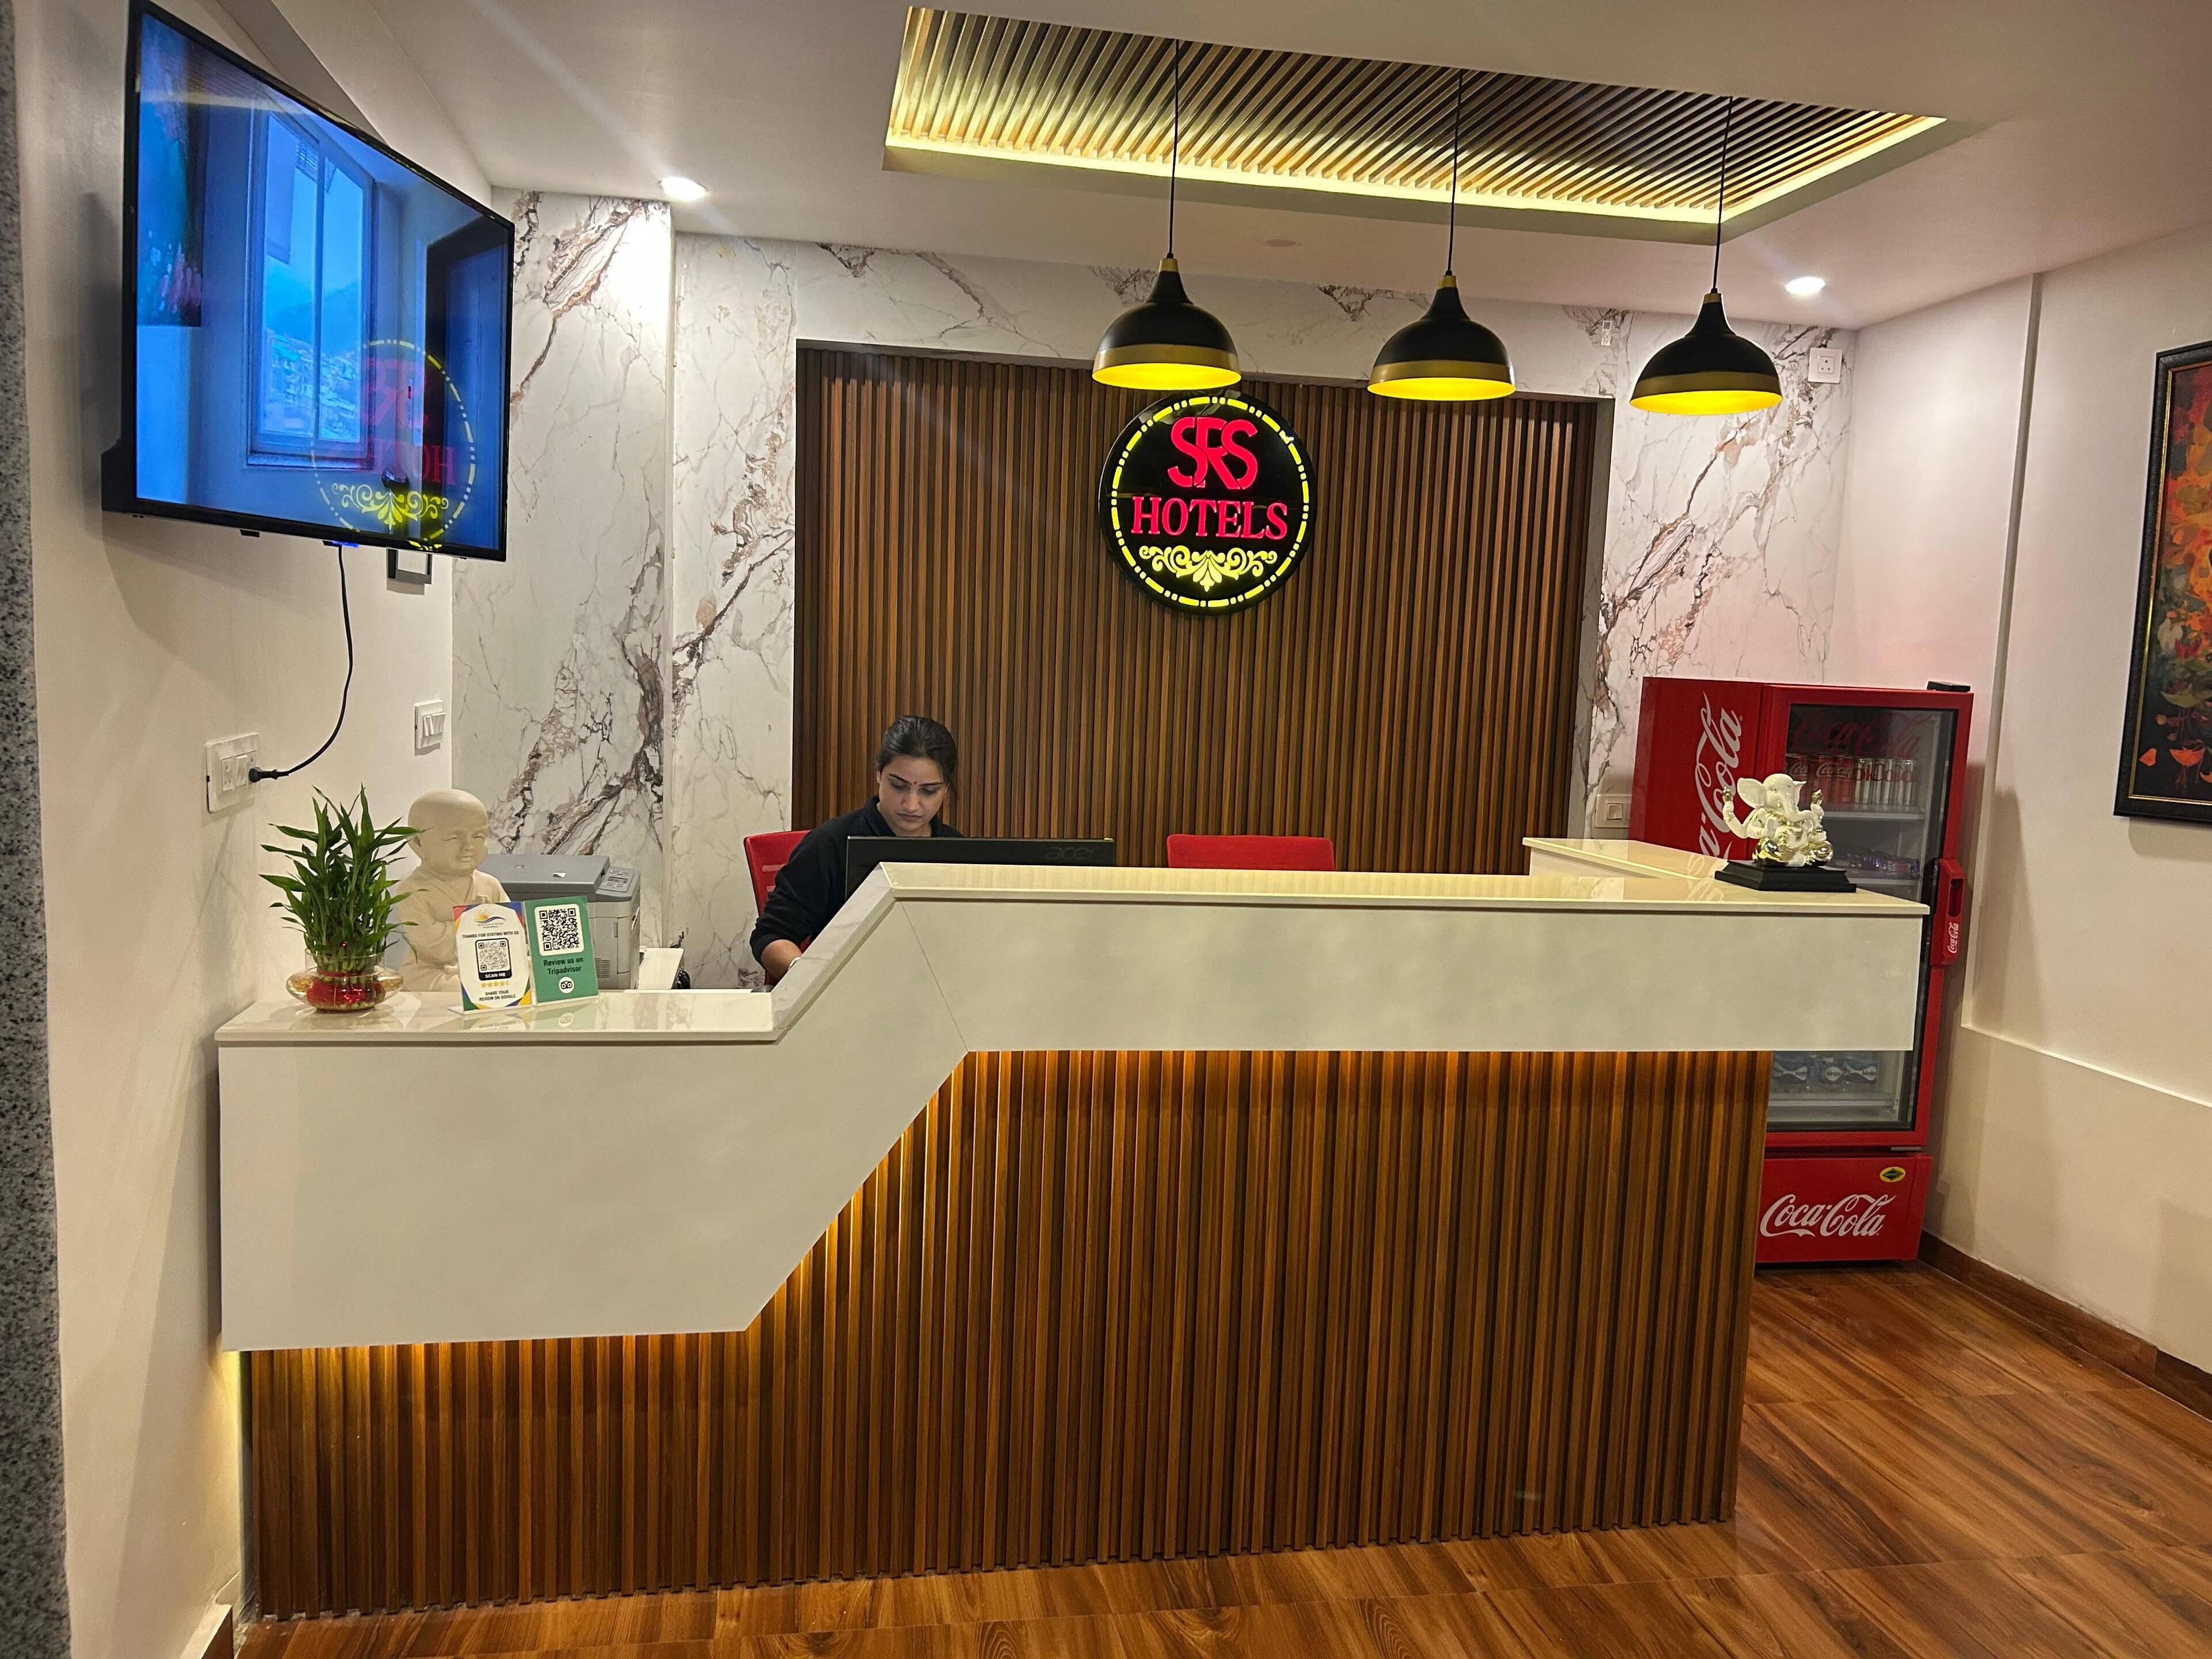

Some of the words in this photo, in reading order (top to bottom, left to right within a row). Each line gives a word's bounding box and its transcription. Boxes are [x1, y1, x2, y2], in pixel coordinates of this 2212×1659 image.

[1167, 416, 1258, 490] SRS
[1131, 496, 1288, 540] HOTELS
[1046, 846, 1101, 860] acer
[1947, 921, 1959, 953] Coca-Cola
[547, 966, 581, 975] Tripadvisor
[1759, 1194, 1897, 1237] Coca-Cola
